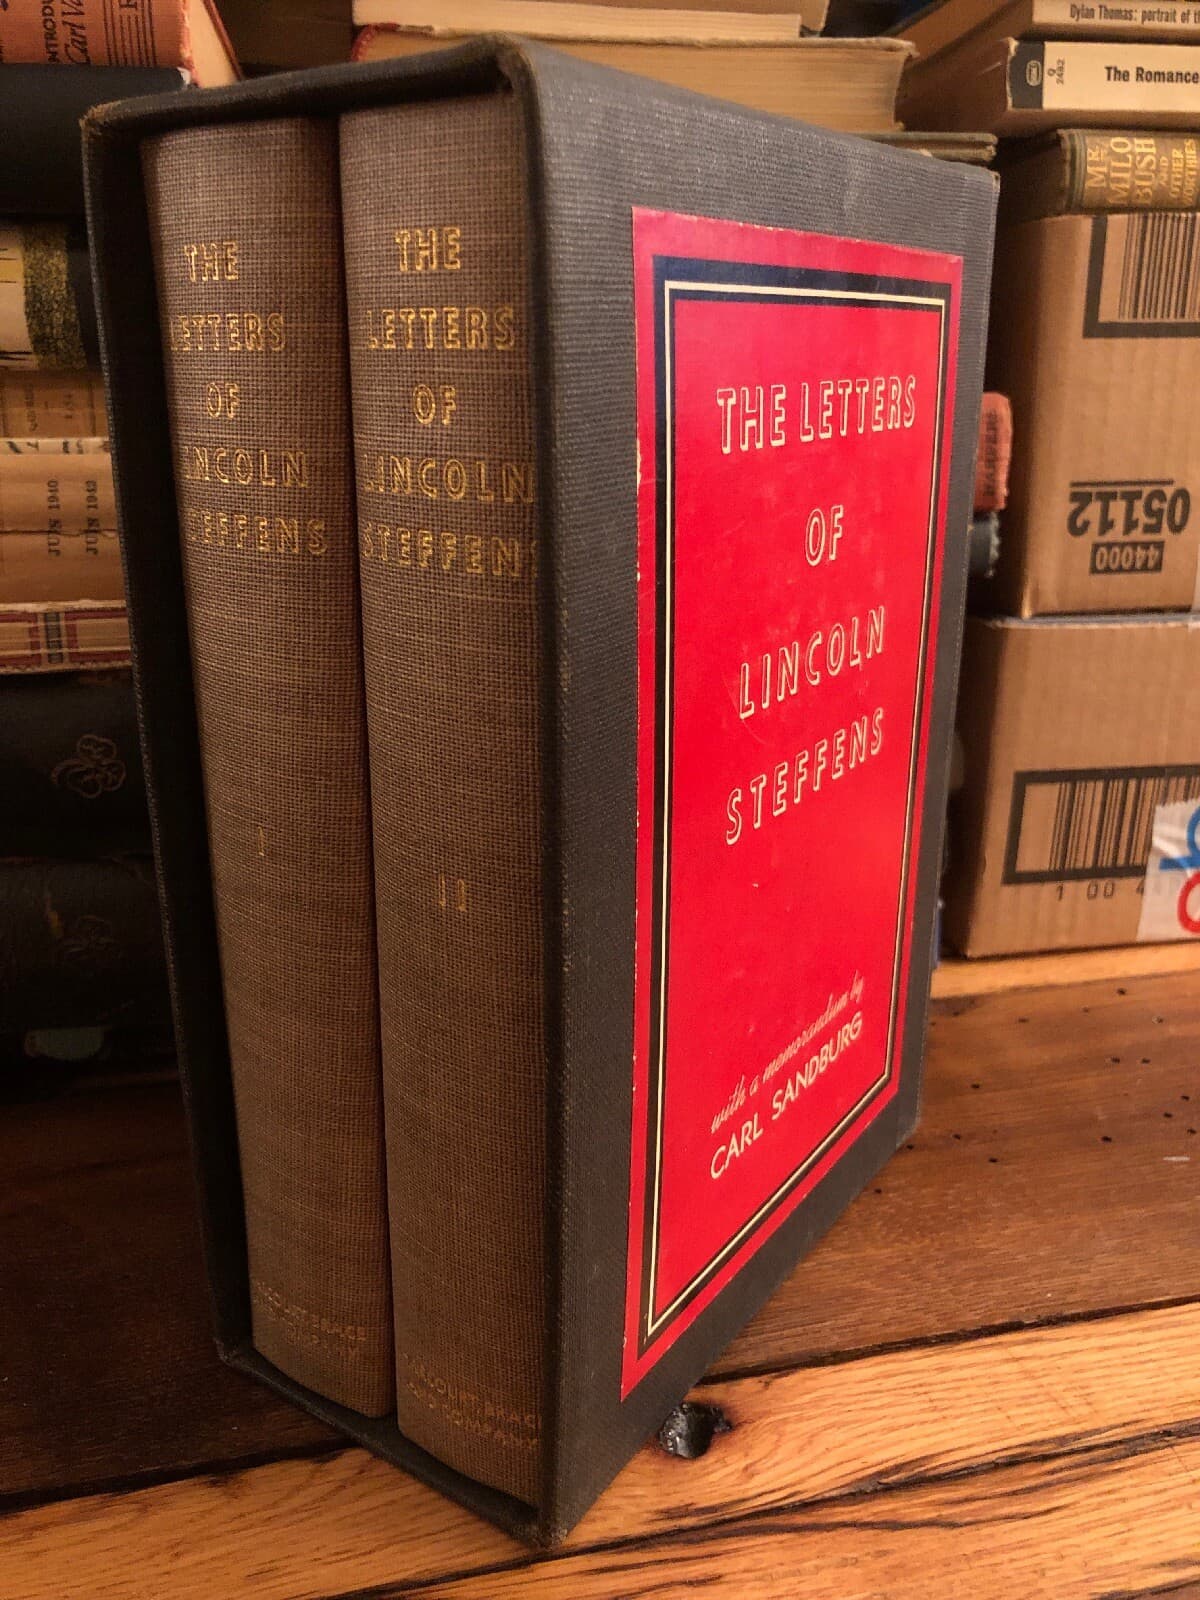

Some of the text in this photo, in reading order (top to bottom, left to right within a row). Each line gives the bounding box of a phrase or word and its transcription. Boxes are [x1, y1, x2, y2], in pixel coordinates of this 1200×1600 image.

[1070, 4, 1095, 21] Dylan
[1099, 5, 1138, 21] Thomas:
[1141, 7, 1176, 24] portrait
[1181, 9, 1191, 24] of
[1105, 66, 1199, 84] The Romance
[1108, 136, 1132, 204] MILO
[1134, 137, 1156, 204] BUSH
[1169, 148, 1184, 198] OTHER
[184, 241, 239, 282] THE
[395, 226, 461, 272] THE
[366, 306, 515, 350] LETTERS
[206, 382, 240, 419] OF
[412, 384, 457, 425] OF
[716, 374, 916, 455] THE LETTERS
[362, 453, 536, 503] LINCOLN
[805, 504, 844, 567] OF
[1066, 487, 1191, 537] 05112
[1095, 544, 1160, 571] 44000
[739, 605, 885, 720] LINCOLN
[726, 706, 884, 846] STEFFENS
[710, 969, 864, 1134] with a memorandum by
[710, 1011, 863, 1180] CARL SANDBURG
